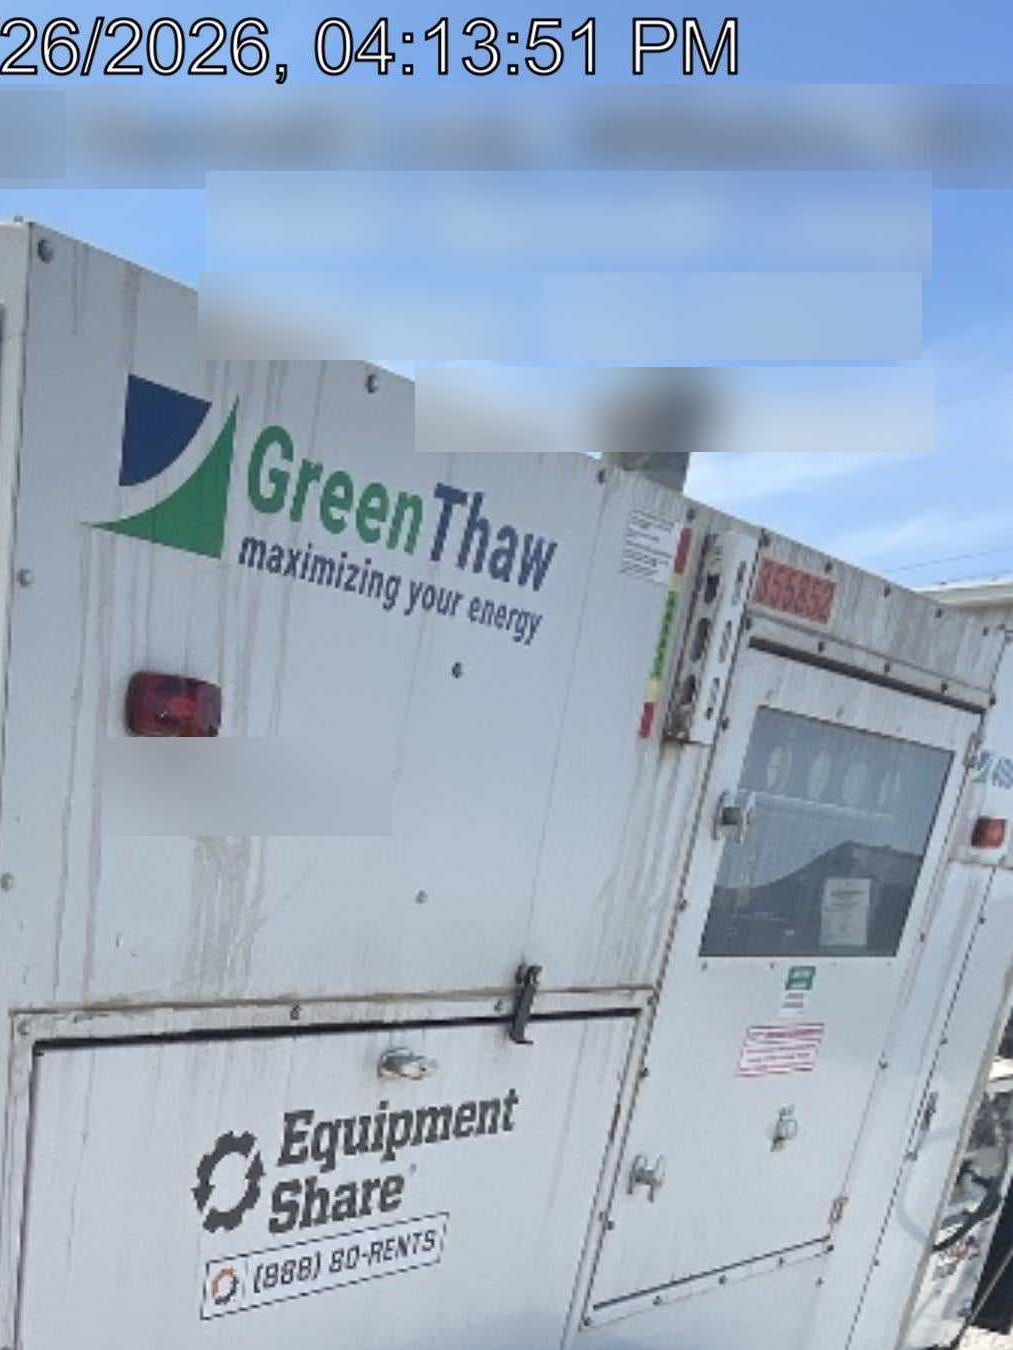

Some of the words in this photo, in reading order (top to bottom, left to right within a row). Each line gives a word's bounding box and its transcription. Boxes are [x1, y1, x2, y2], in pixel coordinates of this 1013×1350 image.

[247, 425, 558, 592] GreenThaw
[238, 534, 402, 611] maximizing
[404, 578, 463, 616] your
[469, 597, 542, 646] energy
[277, 1089, 519, 1173] Equipment
[269, 1170, 405, 1233] Share
[252, 1251, 321, 1293] (888)
[329, 1229, 436, 1273] 80-RENTS
